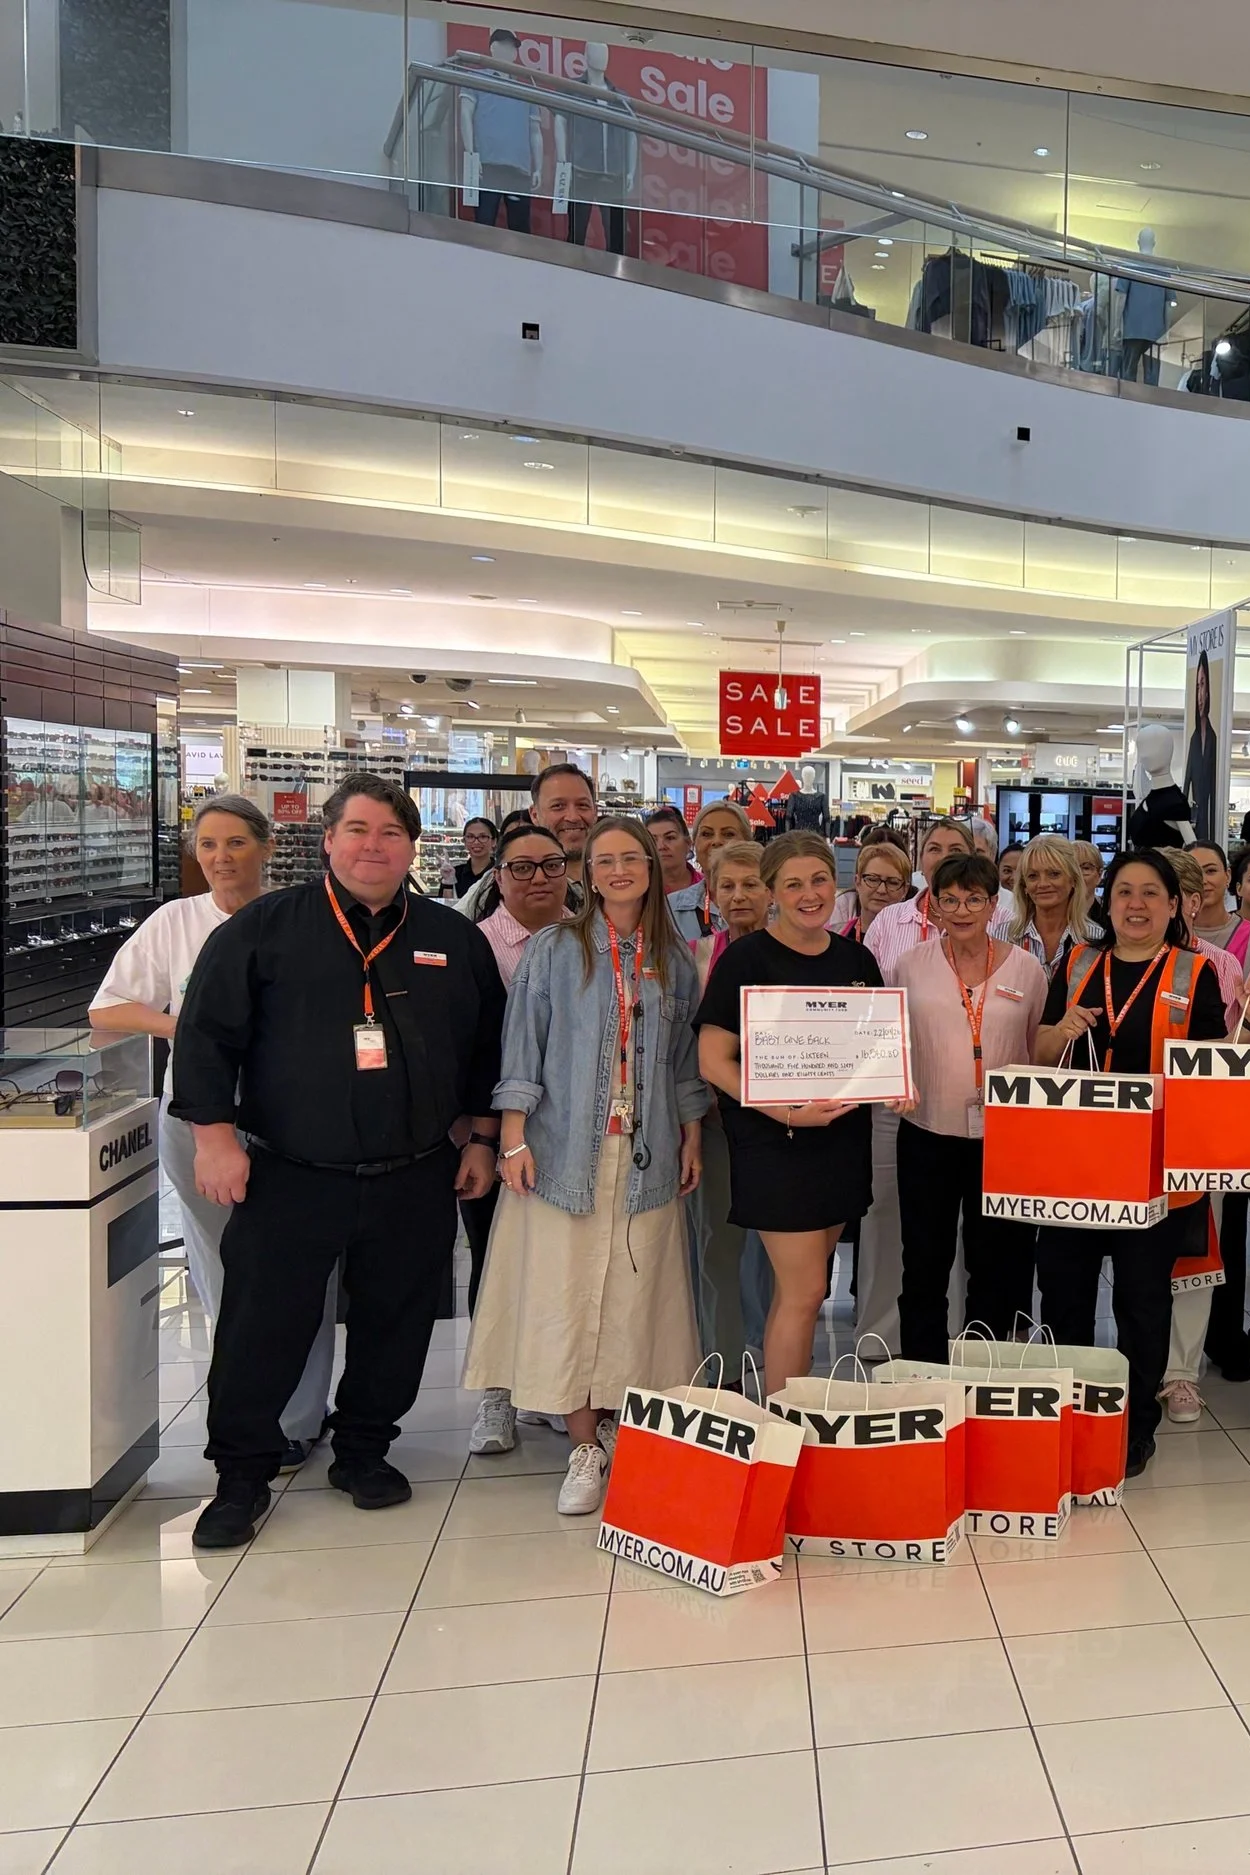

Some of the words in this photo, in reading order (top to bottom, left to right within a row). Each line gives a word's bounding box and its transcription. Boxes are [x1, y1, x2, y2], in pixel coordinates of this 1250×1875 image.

[640, 66, 734, 123] Sale
[726, 715, 815, 737] SALE
[901, 776, 923, 785] seed
[755, 1034, 780, 1045] BABY
[807, 1034, 831, 1045] BACK
[800, 1051, 829, 1060] SIXTEEN
[988, 1075, 1153, 1110] MYER
[99, 1122, 153, 1171] CHANEL
[985, 1196, 1149, 1225] MYER.COM.AU
[1171, 1272, 1223, 1292] STORE
[623, 1391, 756, 1460] MYER
[599, 1526, 727, 1593] MYER.COM.AU
[830, 1540, 945, 1562] STORE
